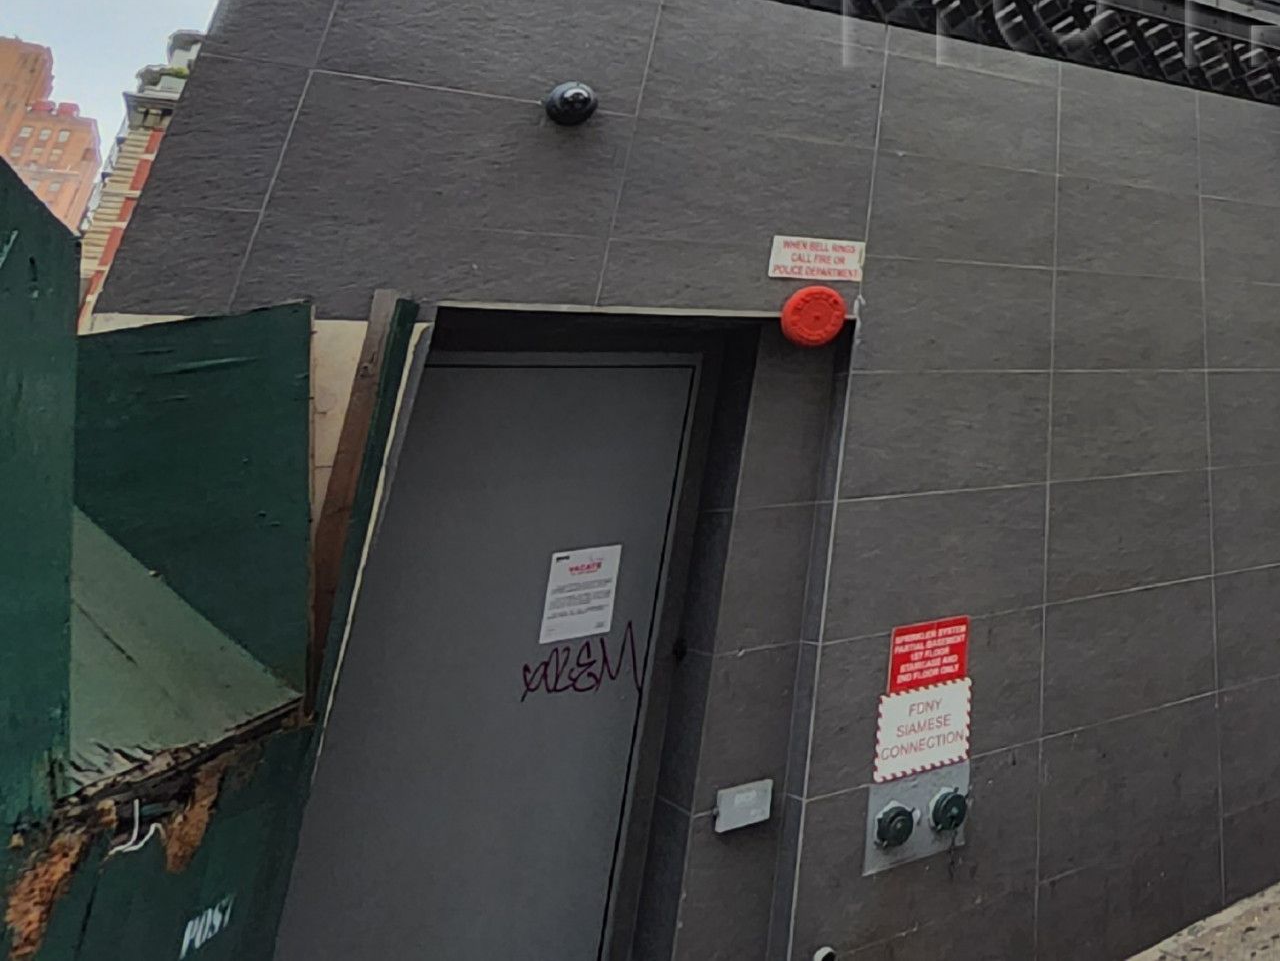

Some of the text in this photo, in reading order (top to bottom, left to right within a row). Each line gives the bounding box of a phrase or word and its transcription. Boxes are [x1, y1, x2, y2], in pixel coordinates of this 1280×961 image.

[791, 252, 811, 263] CALL
[833, 256, 845, 264] OR
[773, 264, 858, 277] POLICE DEPARTMENT
[908, 698, 944, 717] FDNY
[896, 713, 952, 738] SIAMESE
[881, 729, 965, 761] CONNECTION
